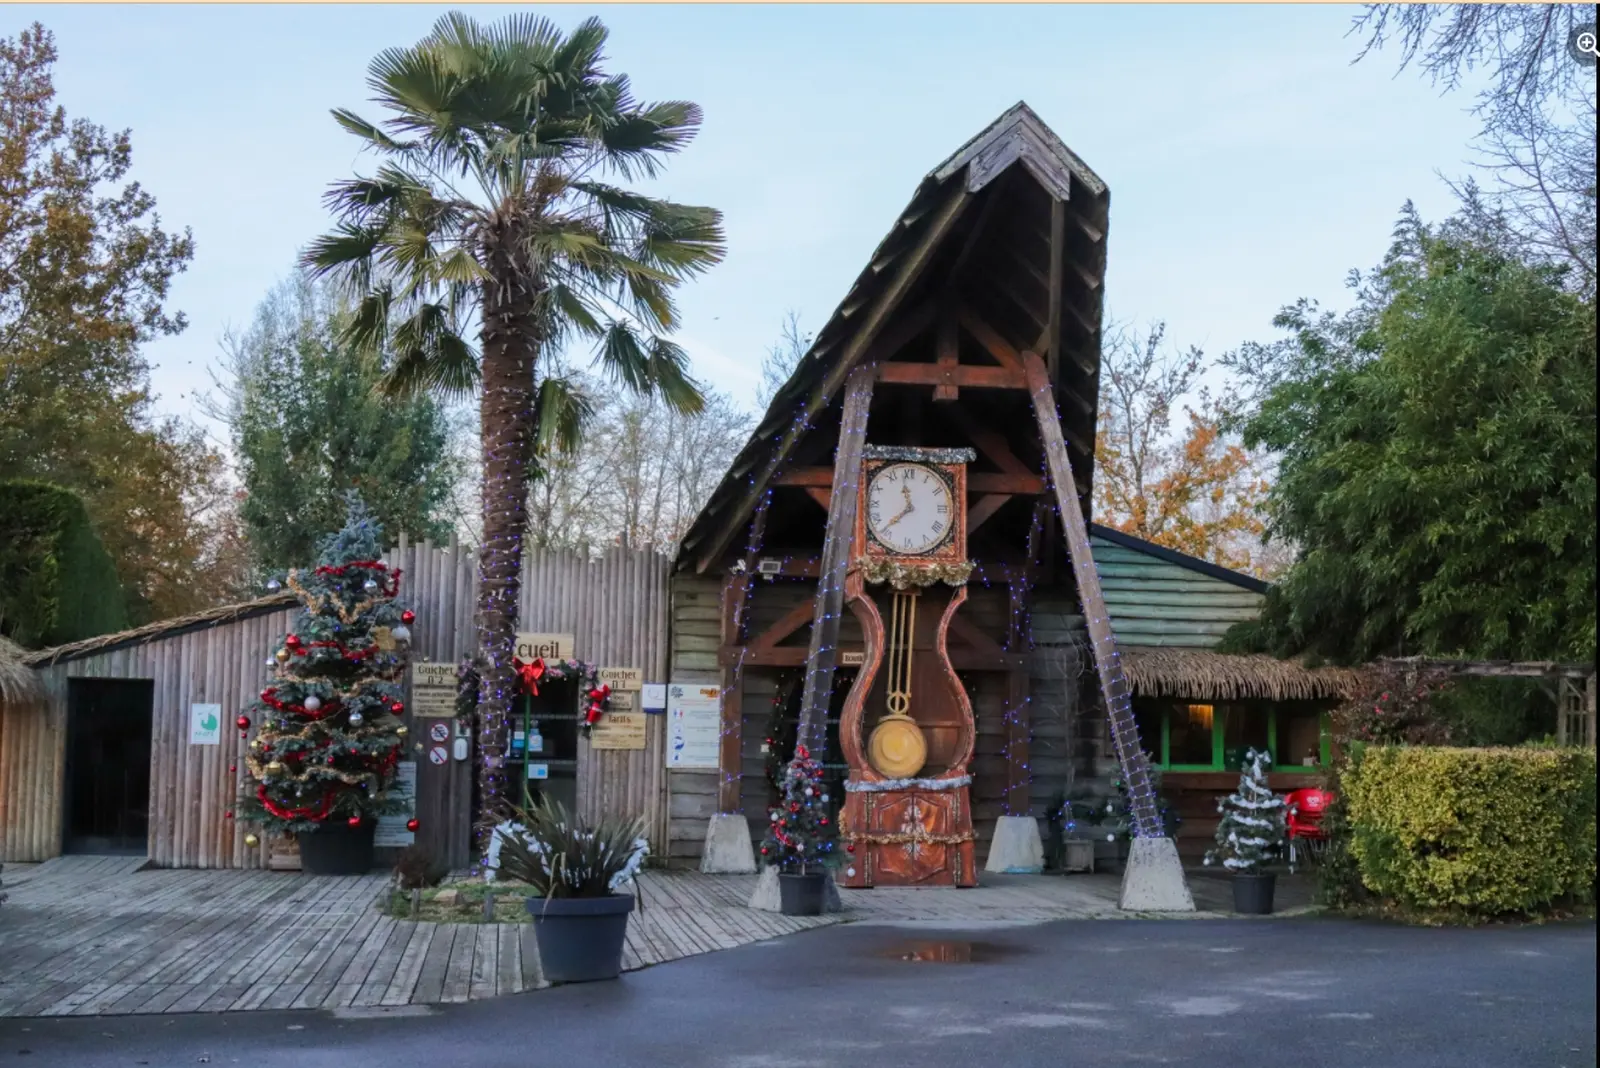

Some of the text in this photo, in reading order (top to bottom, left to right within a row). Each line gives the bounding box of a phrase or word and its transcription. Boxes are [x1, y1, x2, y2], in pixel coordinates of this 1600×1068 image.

[518, 640, 560, 660] cueil
[418, 664, 454, 675] Guichet
[601, 669, 637, 680] Guichet
[608, 714, 632, 724] Tarifs
